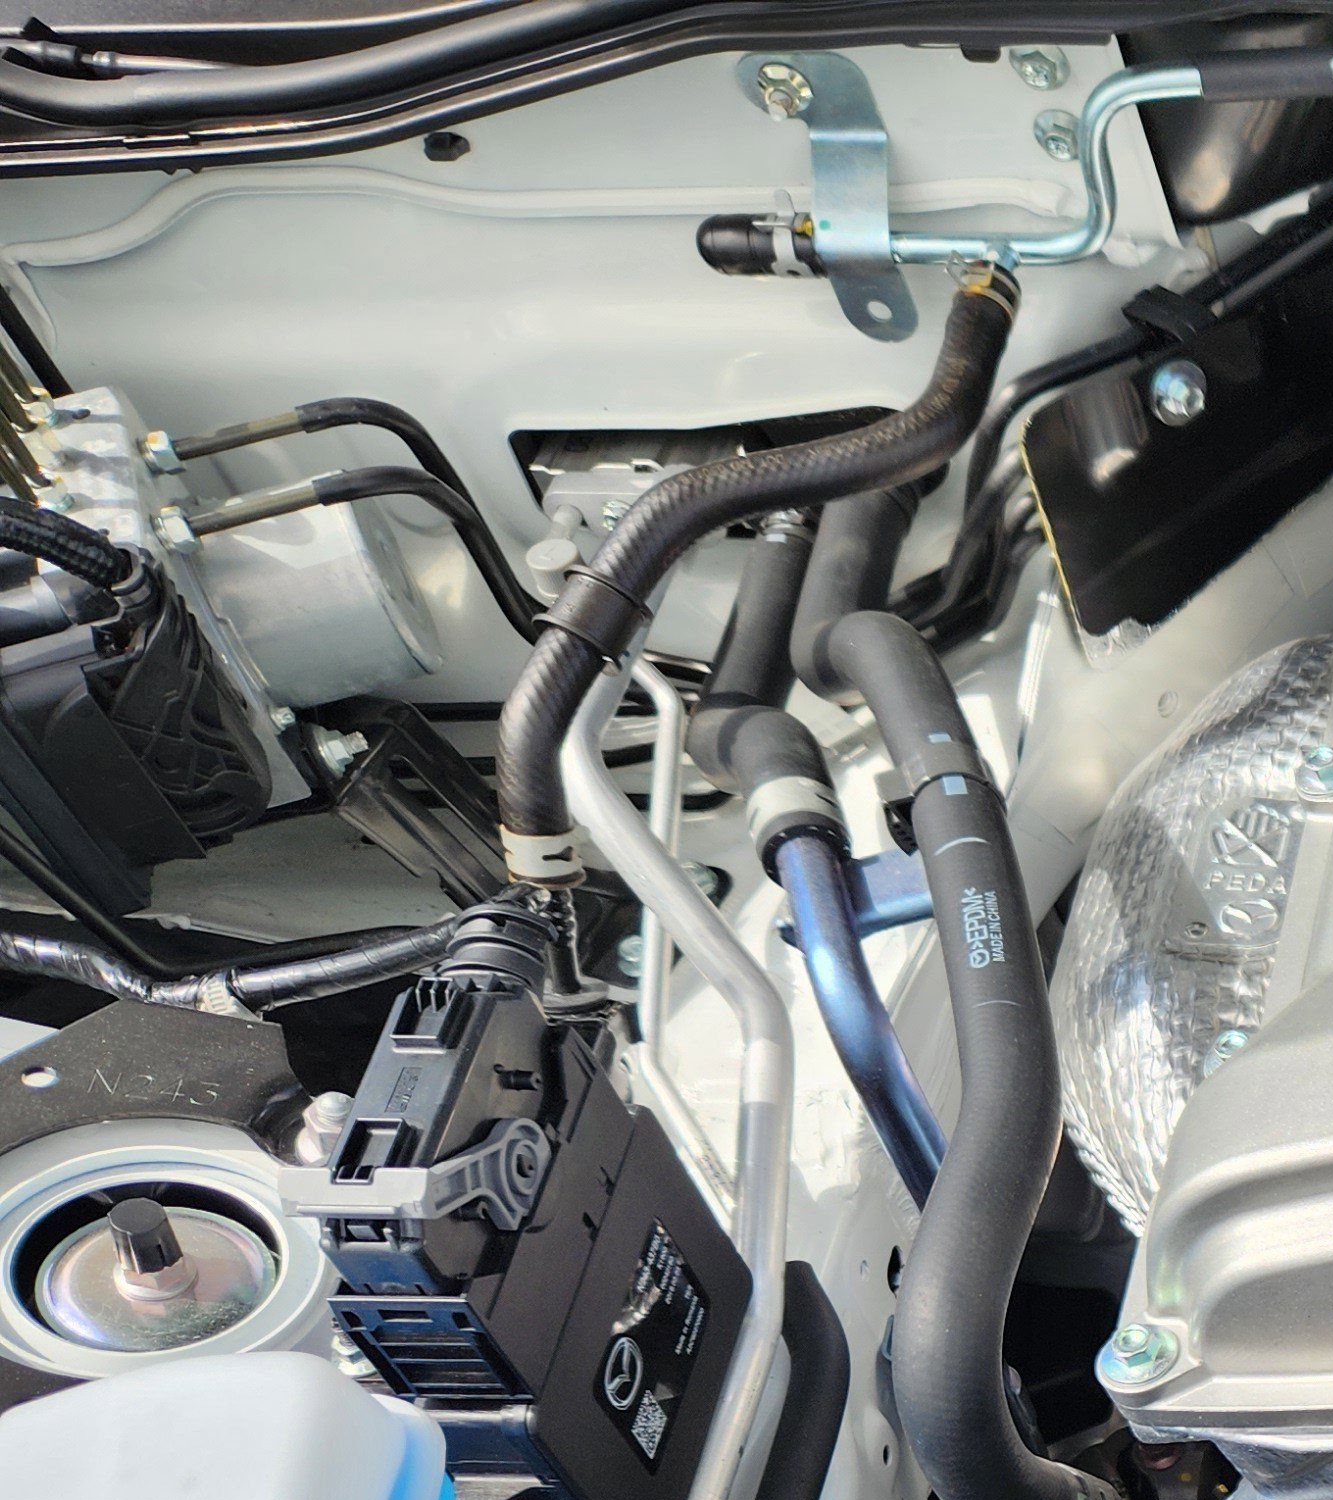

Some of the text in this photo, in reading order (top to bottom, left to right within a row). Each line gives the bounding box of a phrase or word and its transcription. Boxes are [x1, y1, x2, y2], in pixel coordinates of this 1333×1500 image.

[984, 890, 1006, 962] MADE IN CHINA
